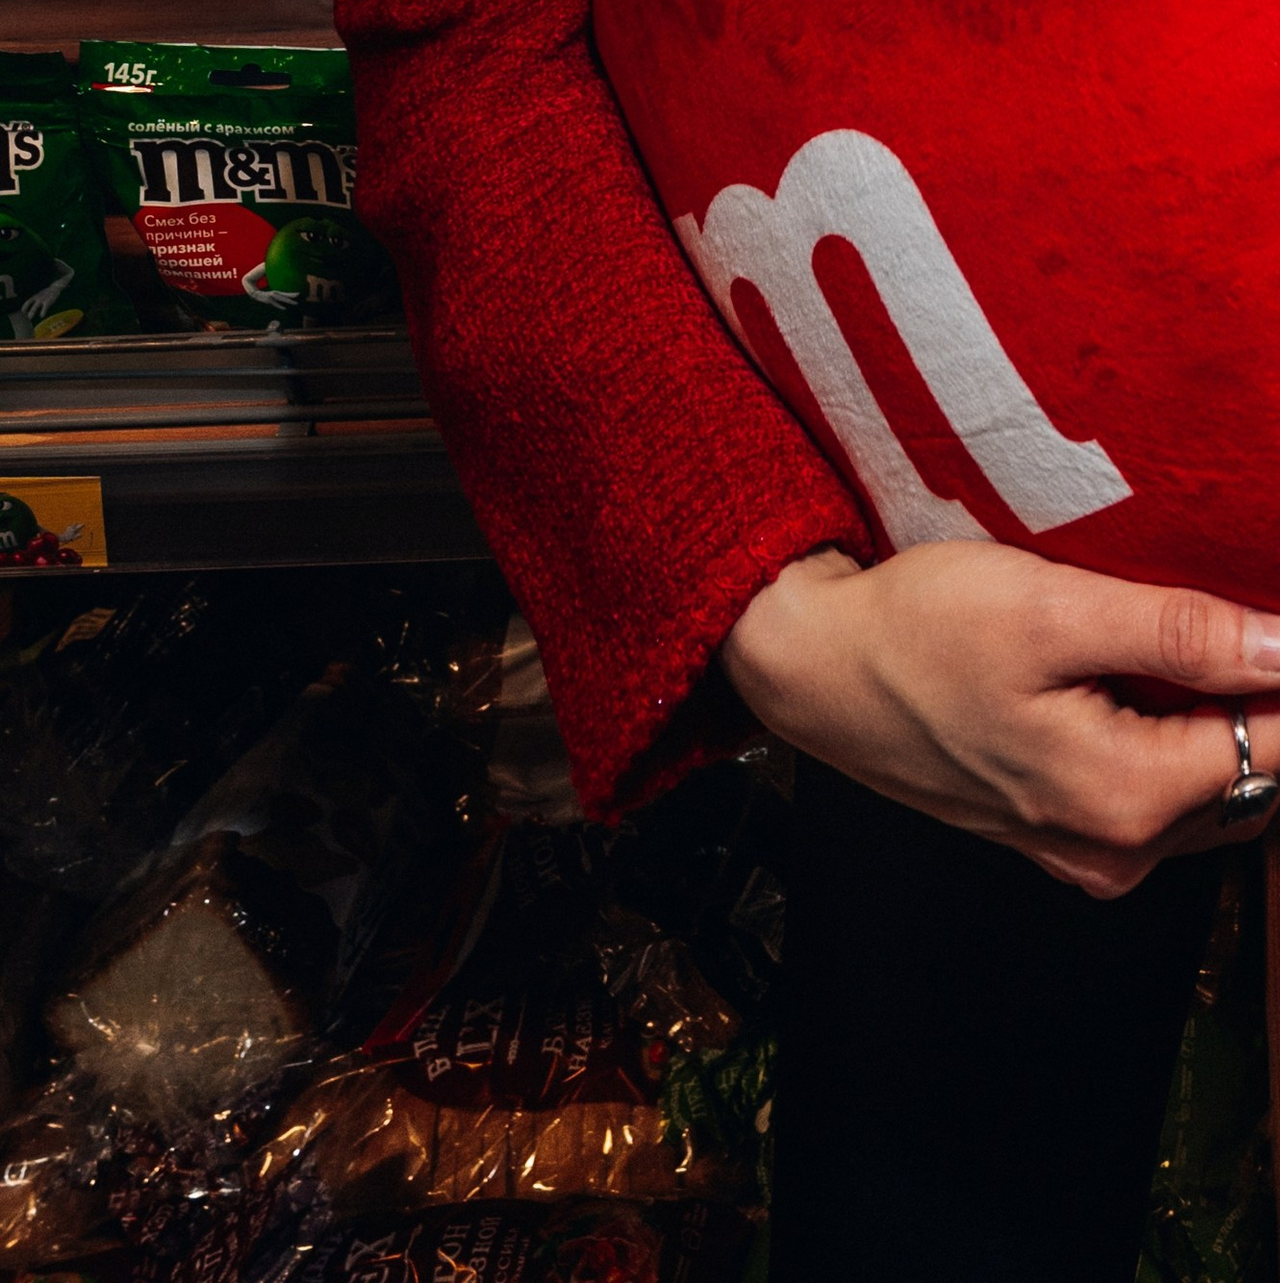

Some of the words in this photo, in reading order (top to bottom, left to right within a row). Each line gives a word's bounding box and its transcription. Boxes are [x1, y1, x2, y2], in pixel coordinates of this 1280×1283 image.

[103, 61, 158, 85] 145г
[128, 119, 200, 134] солёный
[215, 123, 295, 137] арахисом
[144, 214, 185, 228] Смех
[189, 212, 216, 225] без
[146, 229, 214, 243] причины
